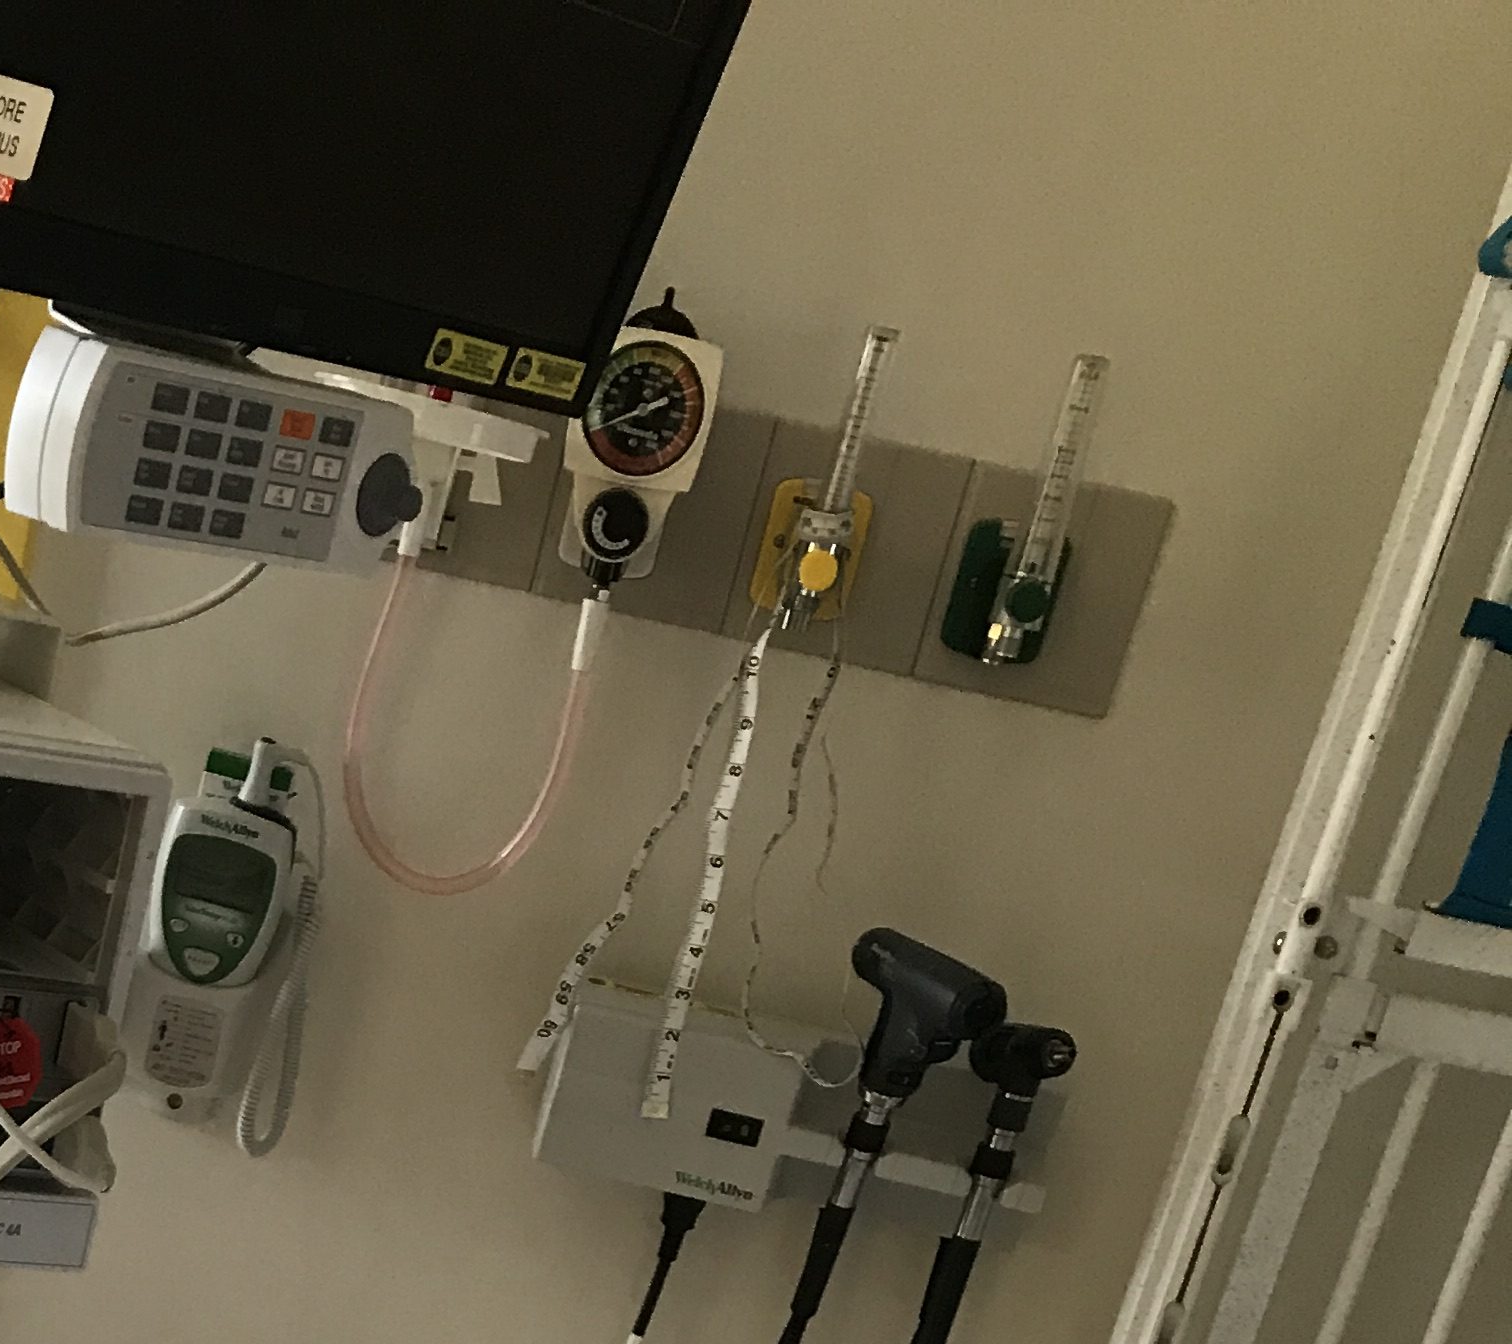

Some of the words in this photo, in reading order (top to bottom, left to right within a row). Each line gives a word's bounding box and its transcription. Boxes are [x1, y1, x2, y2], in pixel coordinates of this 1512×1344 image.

[729, 765, 742, 777] 8
[714, 811, 728, 821] 7
[709, 855, 724, 869] 6
[701, 901, 716, 916] 5
[575, 942, 596, 966] 58
[689, 946, 703, 958] 4
[555, 980, 573, 1006] 59
[675, 990, 690, 1001] 3
[537, 1019, 558, 1038] 60
[665, 1030, 680, 1042] 2
[657, 1074, 670, 1082] 1
